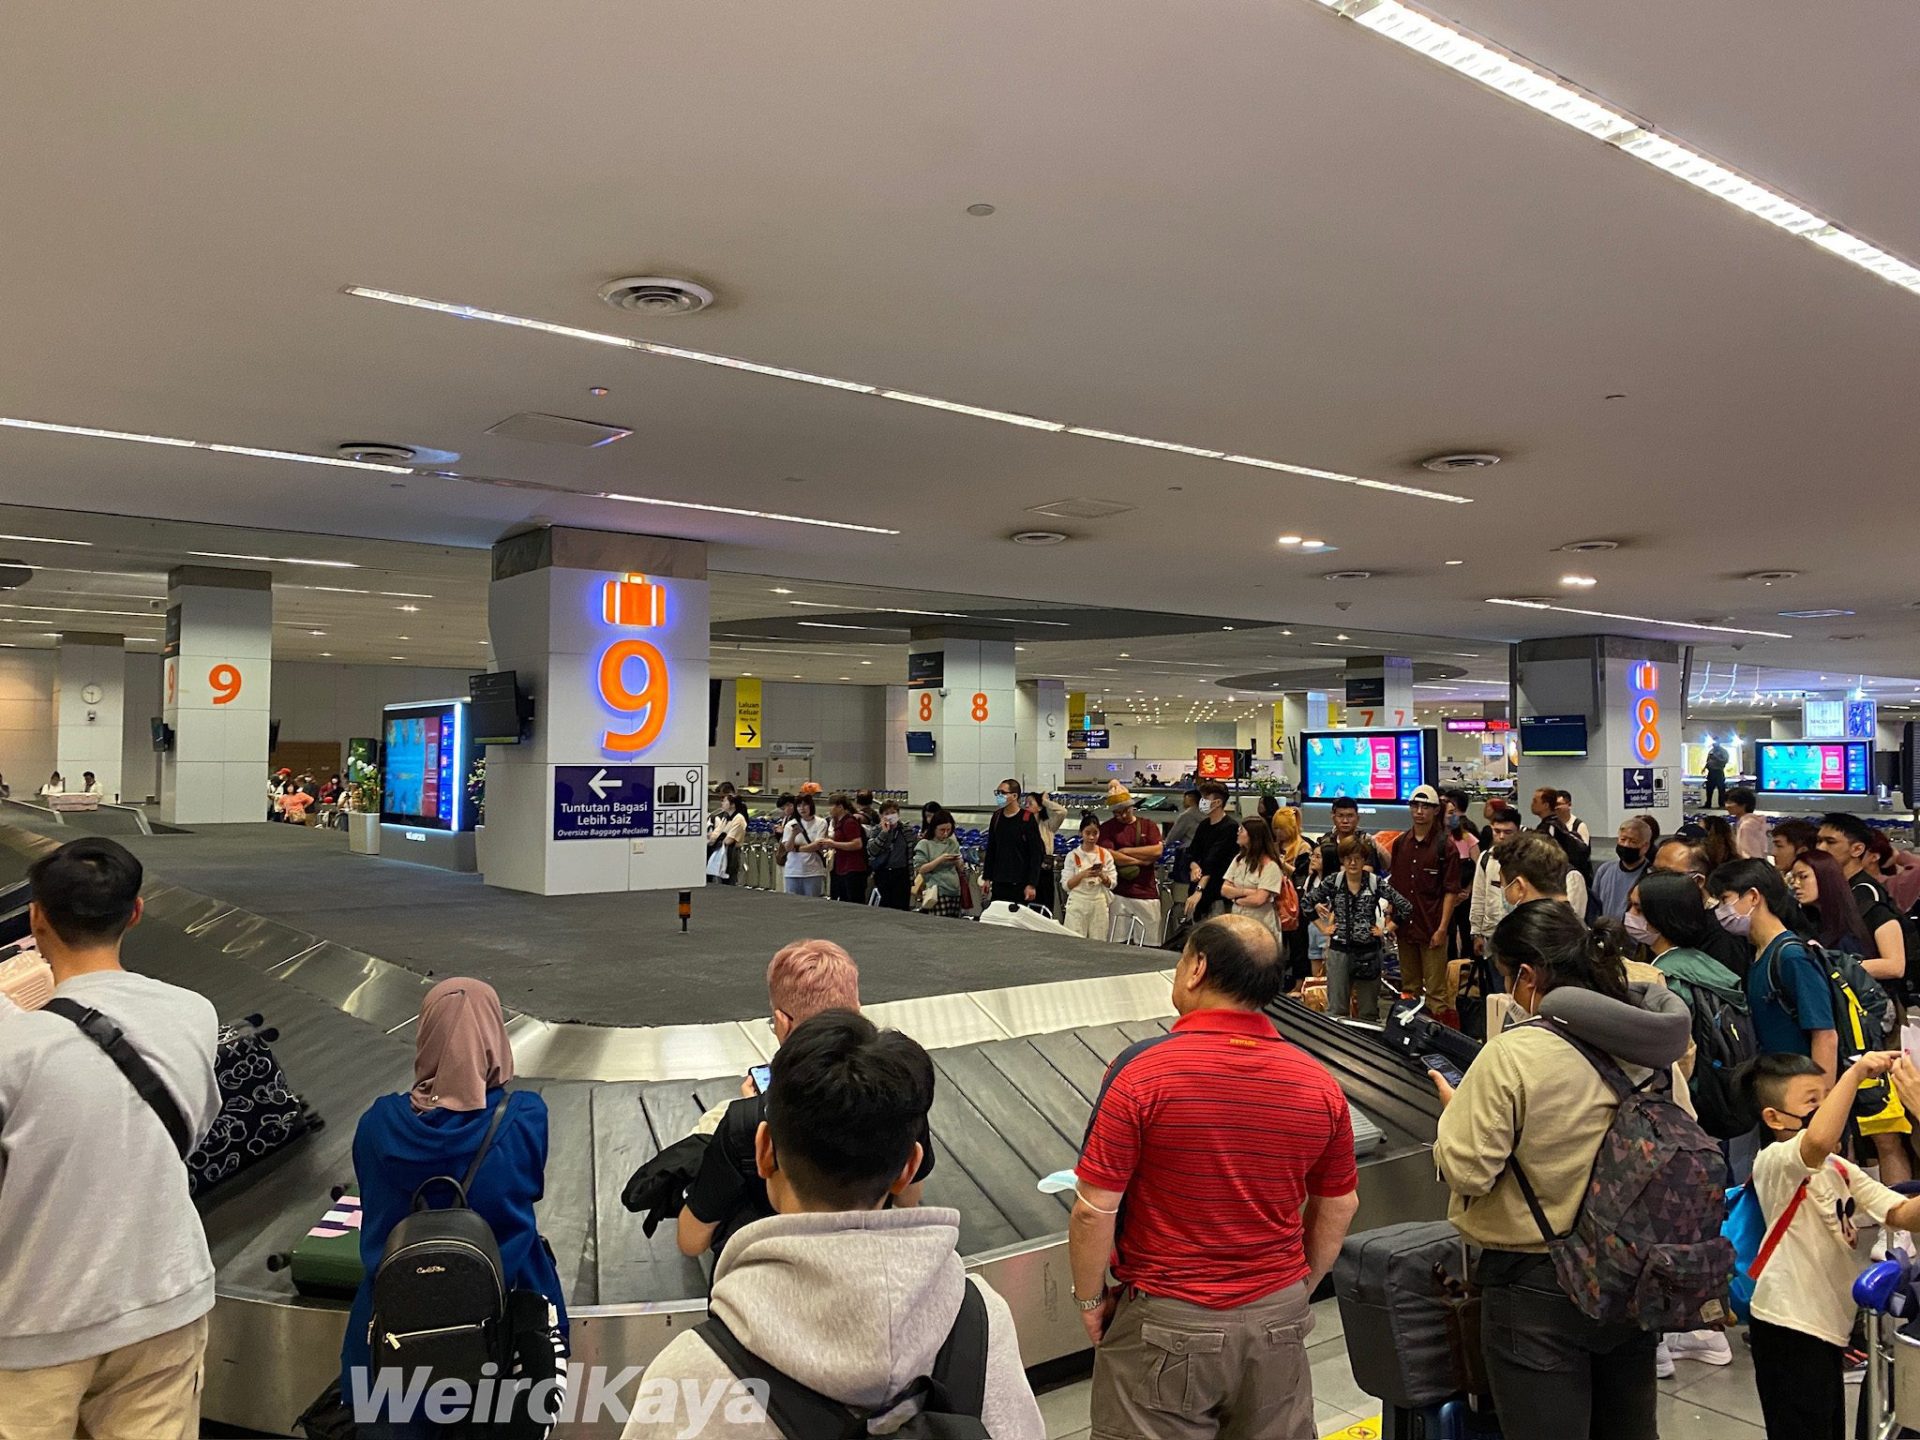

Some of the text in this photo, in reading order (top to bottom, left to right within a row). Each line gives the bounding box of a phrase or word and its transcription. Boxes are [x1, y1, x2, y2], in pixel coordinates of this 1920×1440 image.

[208, 664, 242, 705] 9
[598, 638, 670, 752] 9
[920, 692, 932, 722] 8
[971, 692, 989, 722] 8
[1360, 709, 1374, 727] 7
[1394, 709, 1405, 727] 7
[1636, 696, 1661, 762] 8
[560, 801, 648, 814] Tuntutan Bagasi
[577, 814, 632, 825] Lebih Saiz
[557, 827, 649, 837] Oversize Baggage Reclaim
